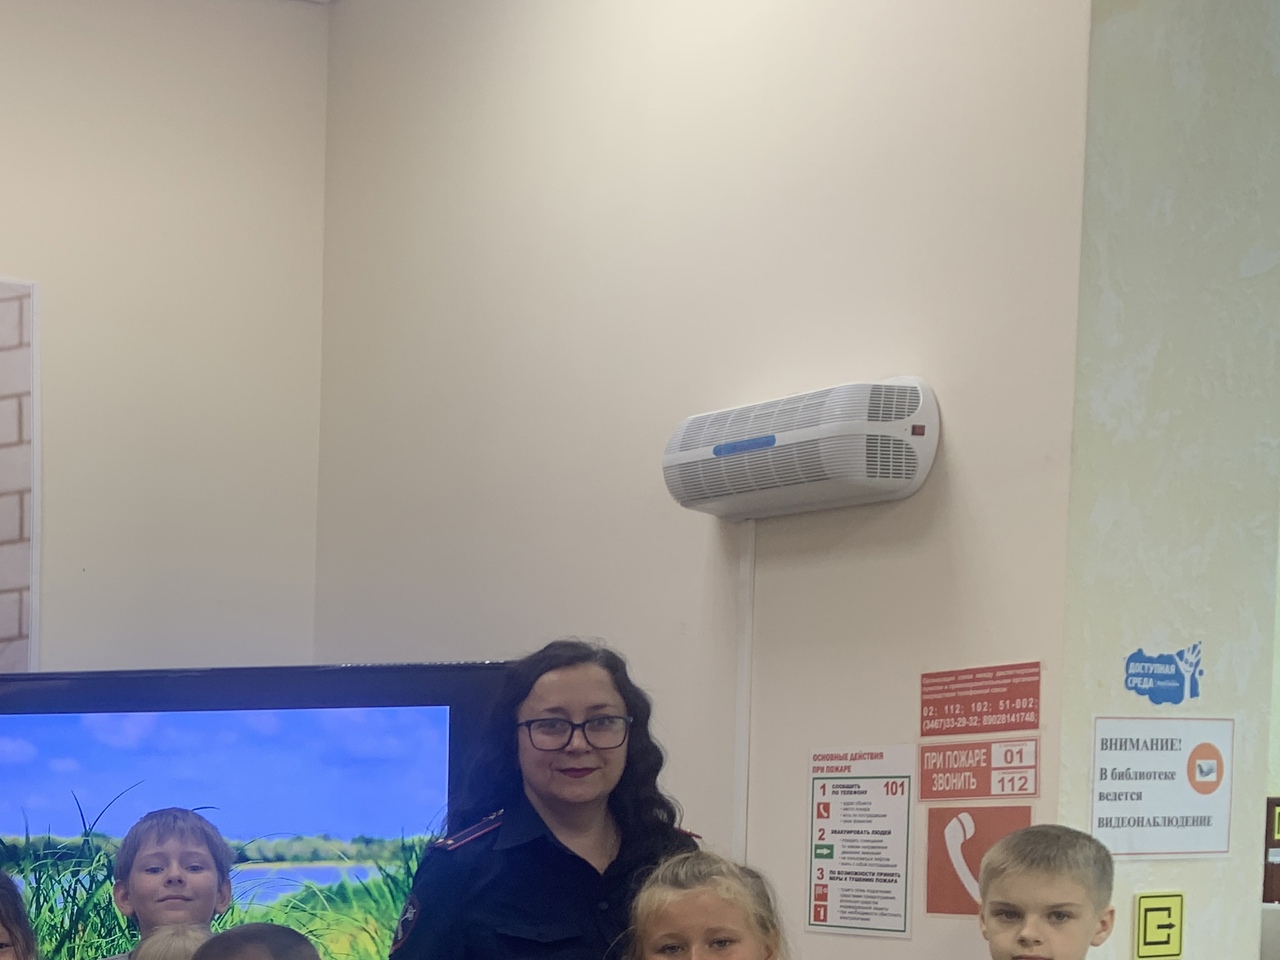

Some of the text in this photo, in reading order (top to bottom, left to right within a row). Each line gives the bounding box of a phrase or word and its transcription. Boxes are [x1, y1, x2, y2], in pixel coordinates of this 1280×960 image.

[1129, 662, 1176, 674] ДОСТУПНАЯ
[1128, 677, 1154, 688] СРЕДА
[1100, 738, 1182, 752] ВНИМАНИЕ!
[812, 752, 884, 762] ОСНОВНЫЕ ДЕЙСТВИЯ
[924, 749, 988, 770] ПРИ ПОЖАРЕ
[1004, 748, 1024, 764] 01
[812, 765, 852, 774] ПРИ ПОЖАРЕ
[1100, 768, 1177, 781] В библиотеке
[884, 780, 905, 796] 101
[932, 772, 978, 792] ЗВОНИТЬ
[998, 776, 1029, 792] 112
[820, 783, 826, 796] 1
[1098, 790, 1143, 802] ведется
[1097, 816, 1213, 829] ВИДЕОНАБЛЮДЕНИЕ
[818, 828, 826, 841] 2
[816, 867, 824, 880] 3
